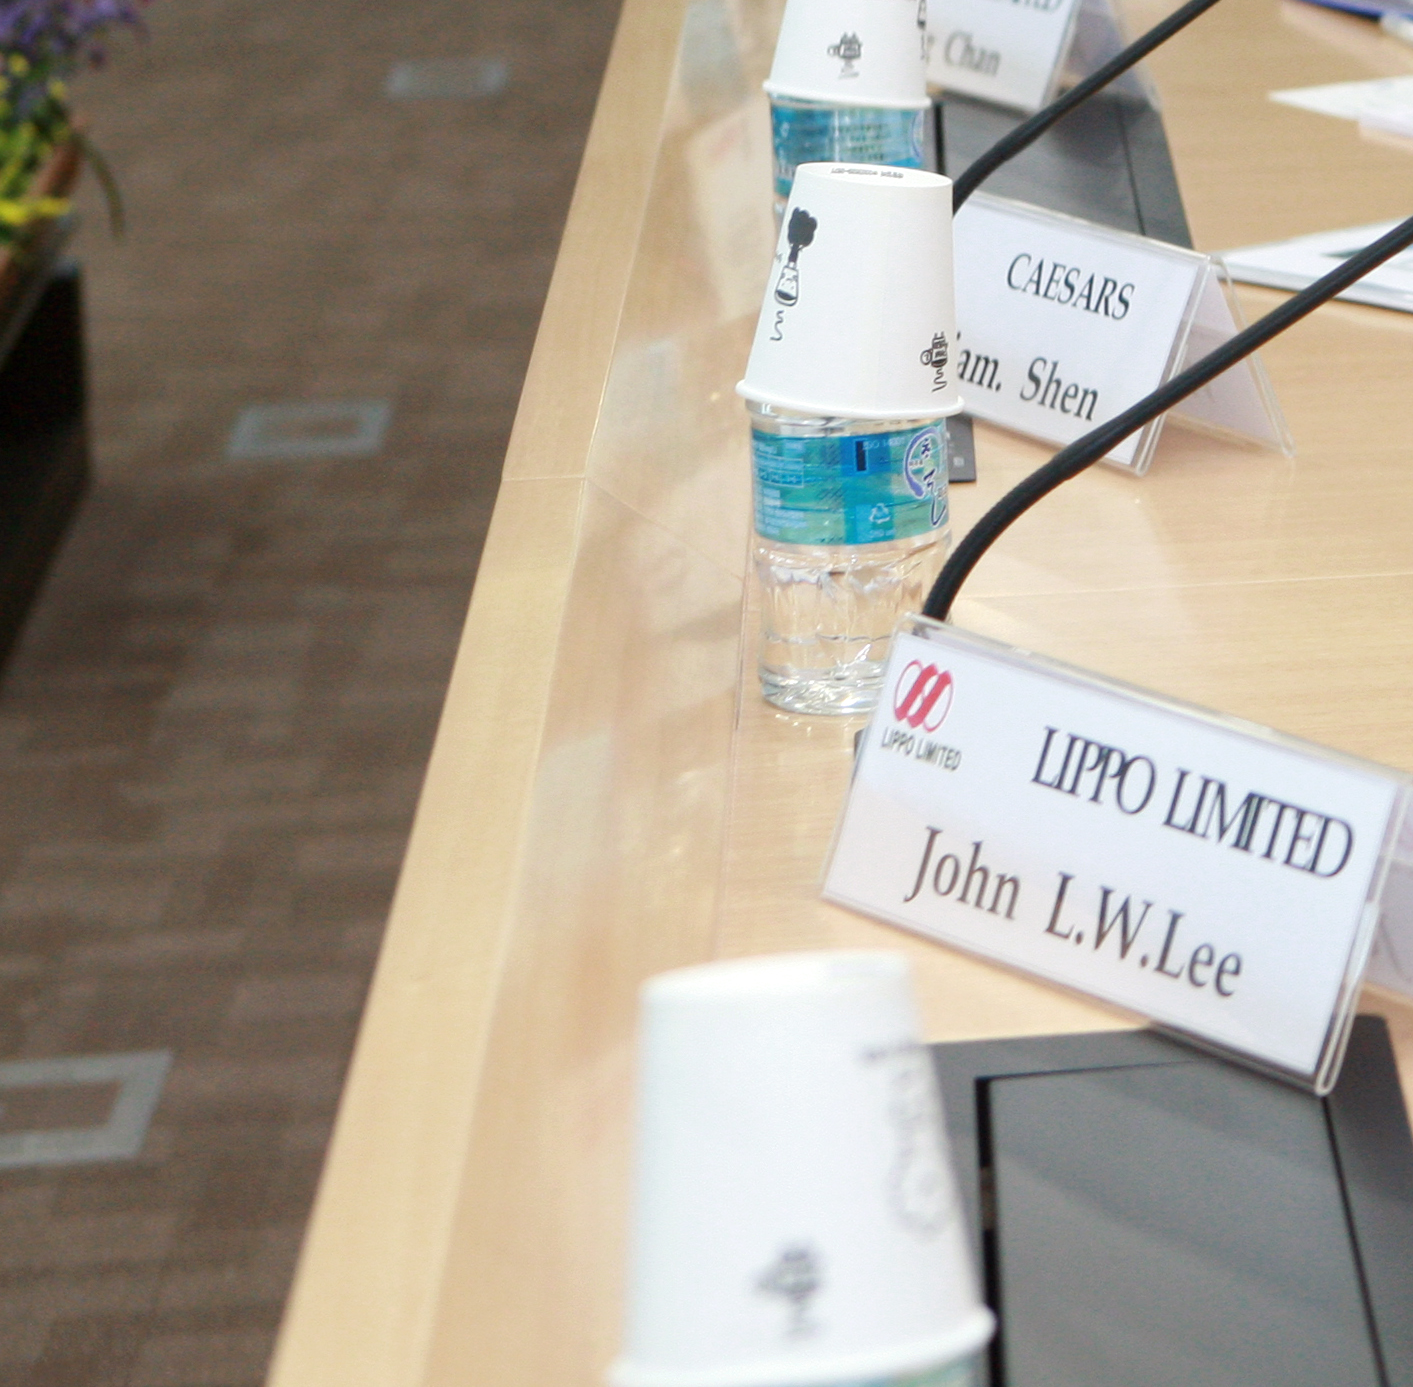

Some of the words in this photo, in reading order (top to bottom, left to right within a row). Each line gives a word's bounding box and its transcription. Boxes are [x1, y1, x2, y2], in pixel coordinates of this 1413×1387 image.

[944, 30, 1001, 76] Chan
[1006, 252, 1136, 321] CAESARS
[1019, 355, 1099, 422] Shen
[881, 726, 916, 756] LIPPO
[915, 738, 962, 772] LIMITED
[1031, 726, 1157, 815] LIPPO
[1162, 767, 1355, 878] LIMITED
[903, 825, 1022, 921] John
[1044, 871, 1243, 998] L.W.Lee
